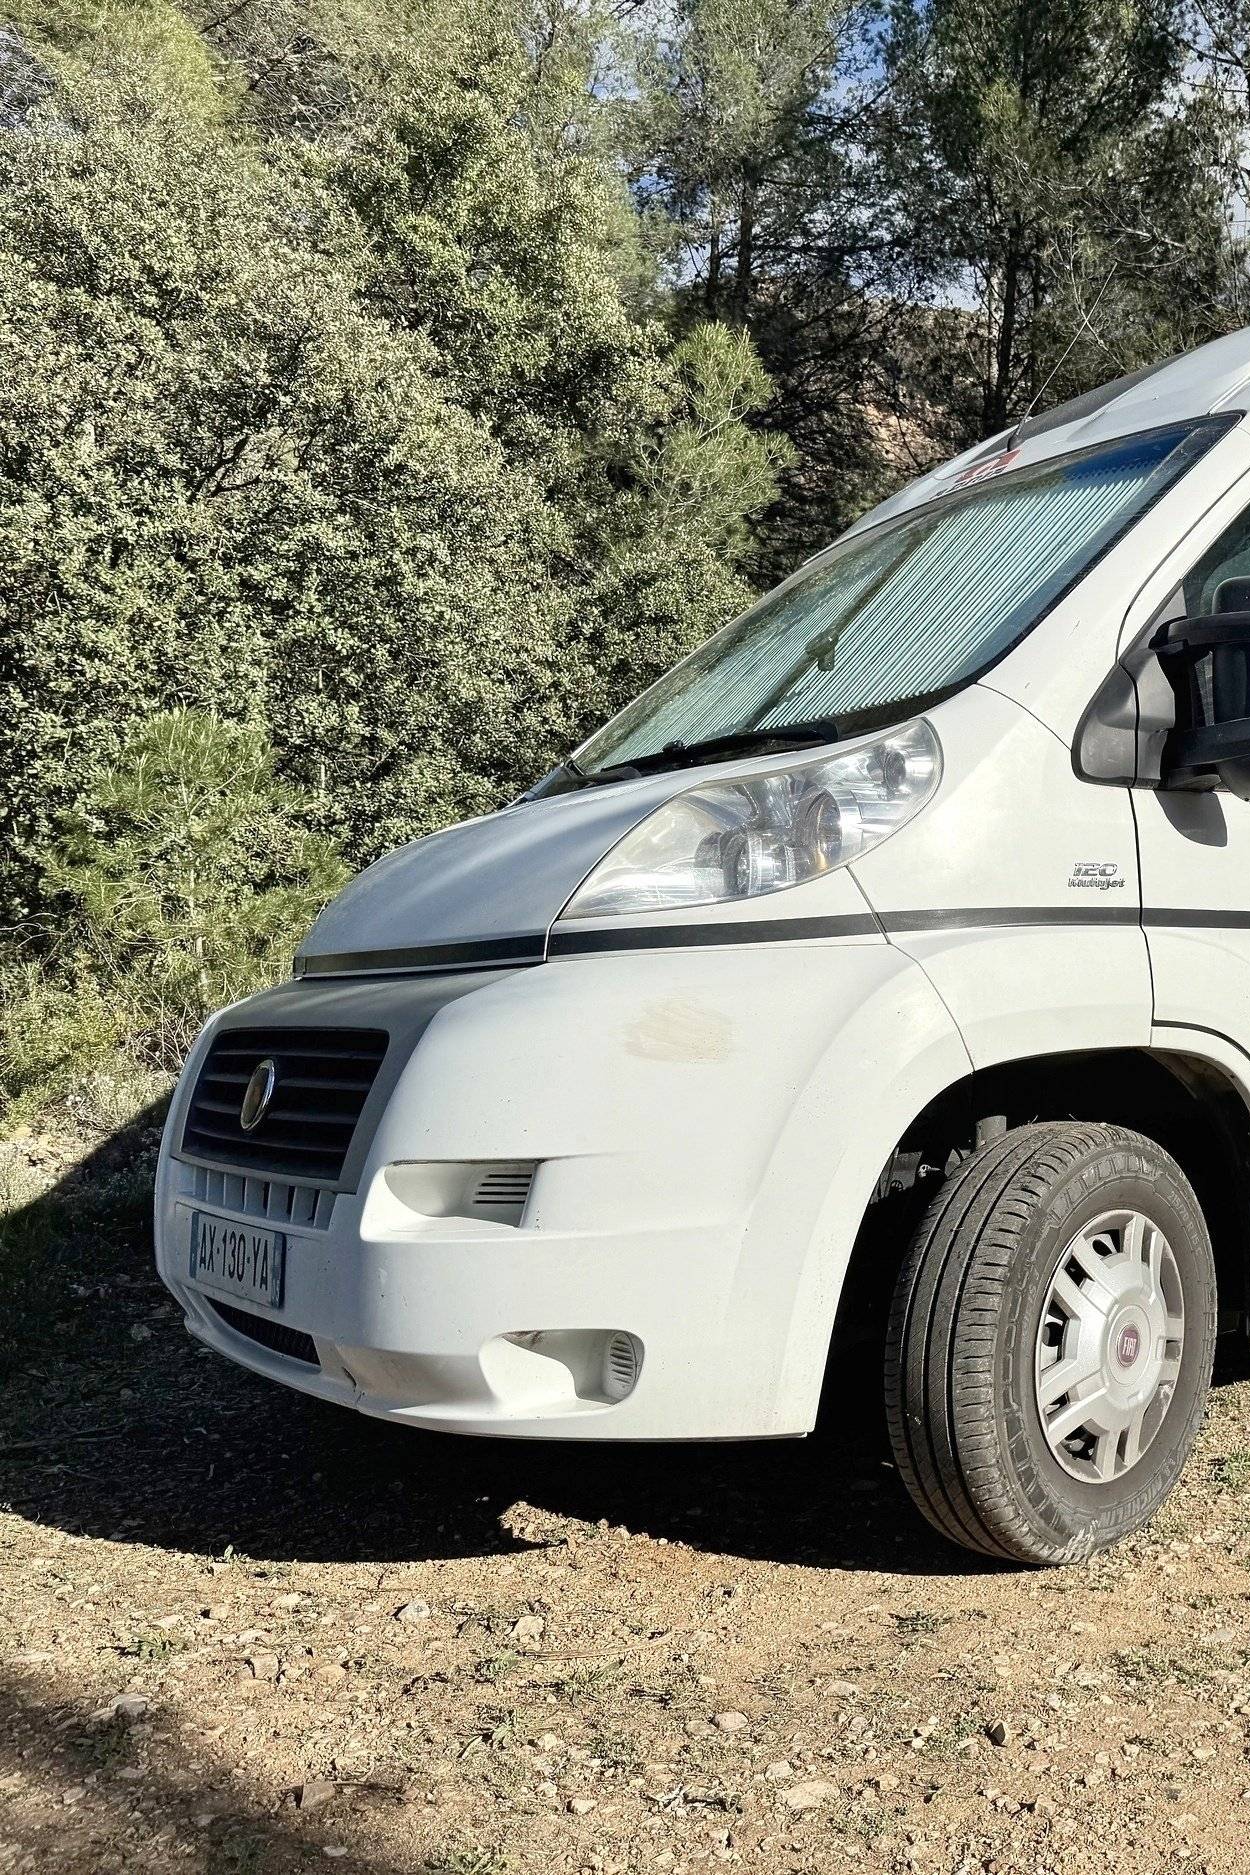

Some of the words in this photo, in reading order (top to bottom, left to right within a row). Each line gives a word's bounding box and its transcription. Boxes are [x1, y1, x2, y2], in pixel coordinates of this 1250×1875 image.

[1073, 863, 1118, 877] 120
[199, 1222, 269, 1292] AX-130-YA
[1121, 1336, 1138, 1357] FIAT
